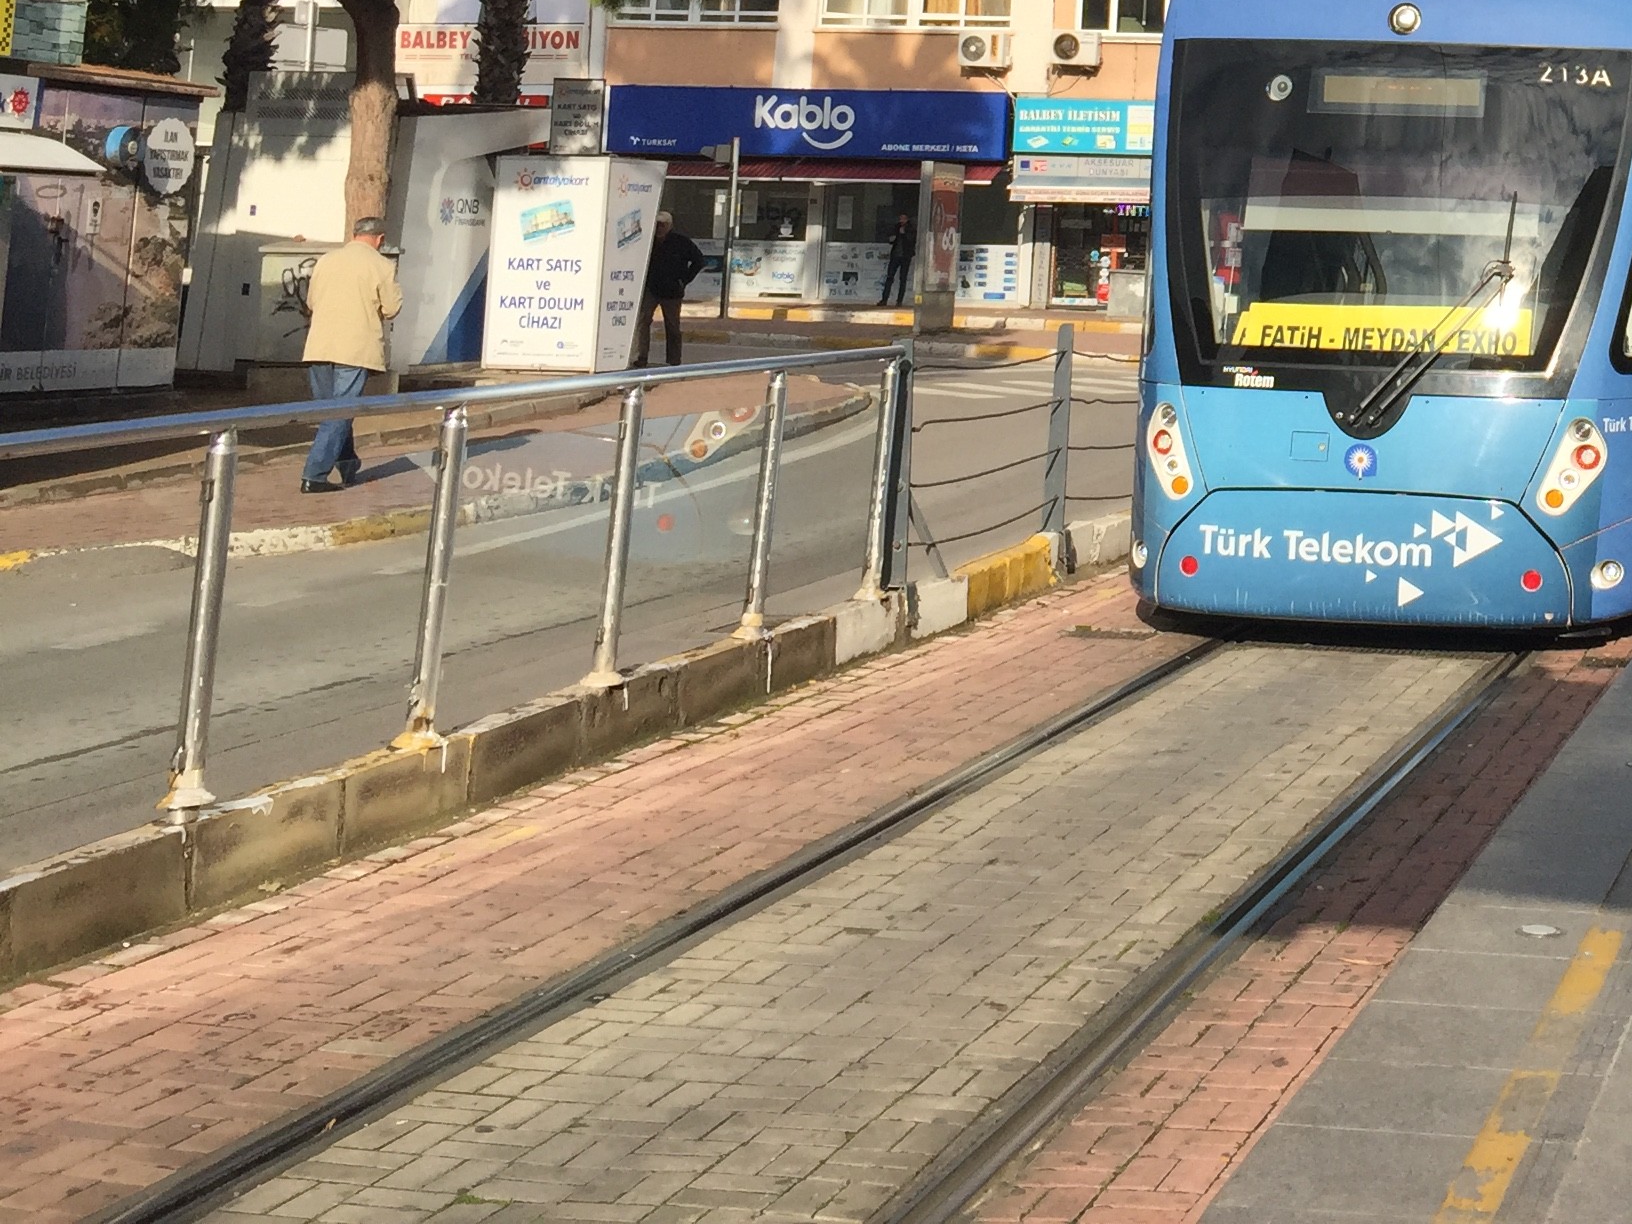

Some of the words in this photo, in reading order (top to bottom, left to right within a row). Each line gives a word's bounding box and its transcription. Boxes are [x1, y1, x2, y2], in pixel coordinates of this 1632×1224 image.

[401, 30, 471, 49] BALBEY
[1539, 61, 1612, 87] 213A
[754, 95, 855, 130] Kablo
[1019, 108, 1065, 121] BALBEY
[881, 144, 910, 152] ABONE
[1084, 159, 1134, 167] AKSESUAR
[533, 174, 590, 188] antalyakart
[456, 198, 480, 215] QNB
[508, 258, 543, 271] KART
[546, 258, 582, 274] SATIŞ
[536, 280, 551, 291] ve
[500, 296, 534, 309] KART
[538, 297, 584, 311] DOLUM
[519, 313, 562, 329] CİHAZI
[16, 362, 78, 380] BELEDİYESİ
[1234, 372, 1275, 388] Rotem
[1603, 417, 1627, 433] Türk
[1200, 524, 1273, 559] Türk
[1283, 529, 1432, 567] Telekom
